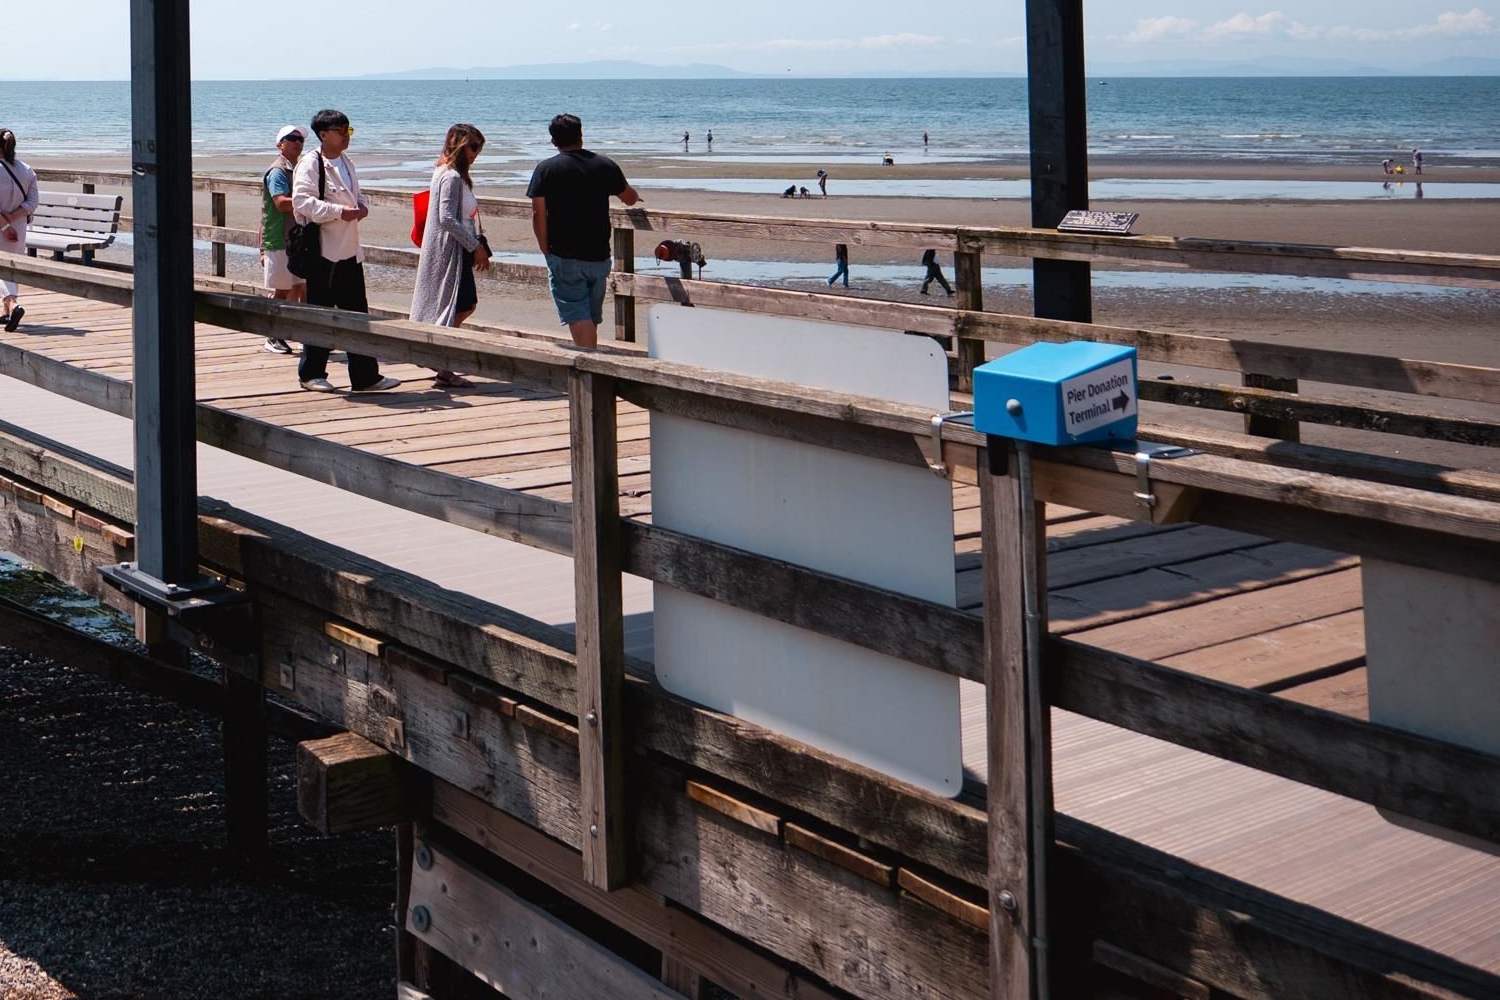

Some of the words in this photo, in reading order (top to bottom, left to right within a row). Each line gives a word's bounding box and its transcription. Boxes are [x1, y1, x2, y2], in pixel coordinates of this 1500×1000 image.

[1066, 388, 1087, 404] Pier
[1088, 374, 1128, 398] Donation
[1069, 398, 1111, 425] Terminal
